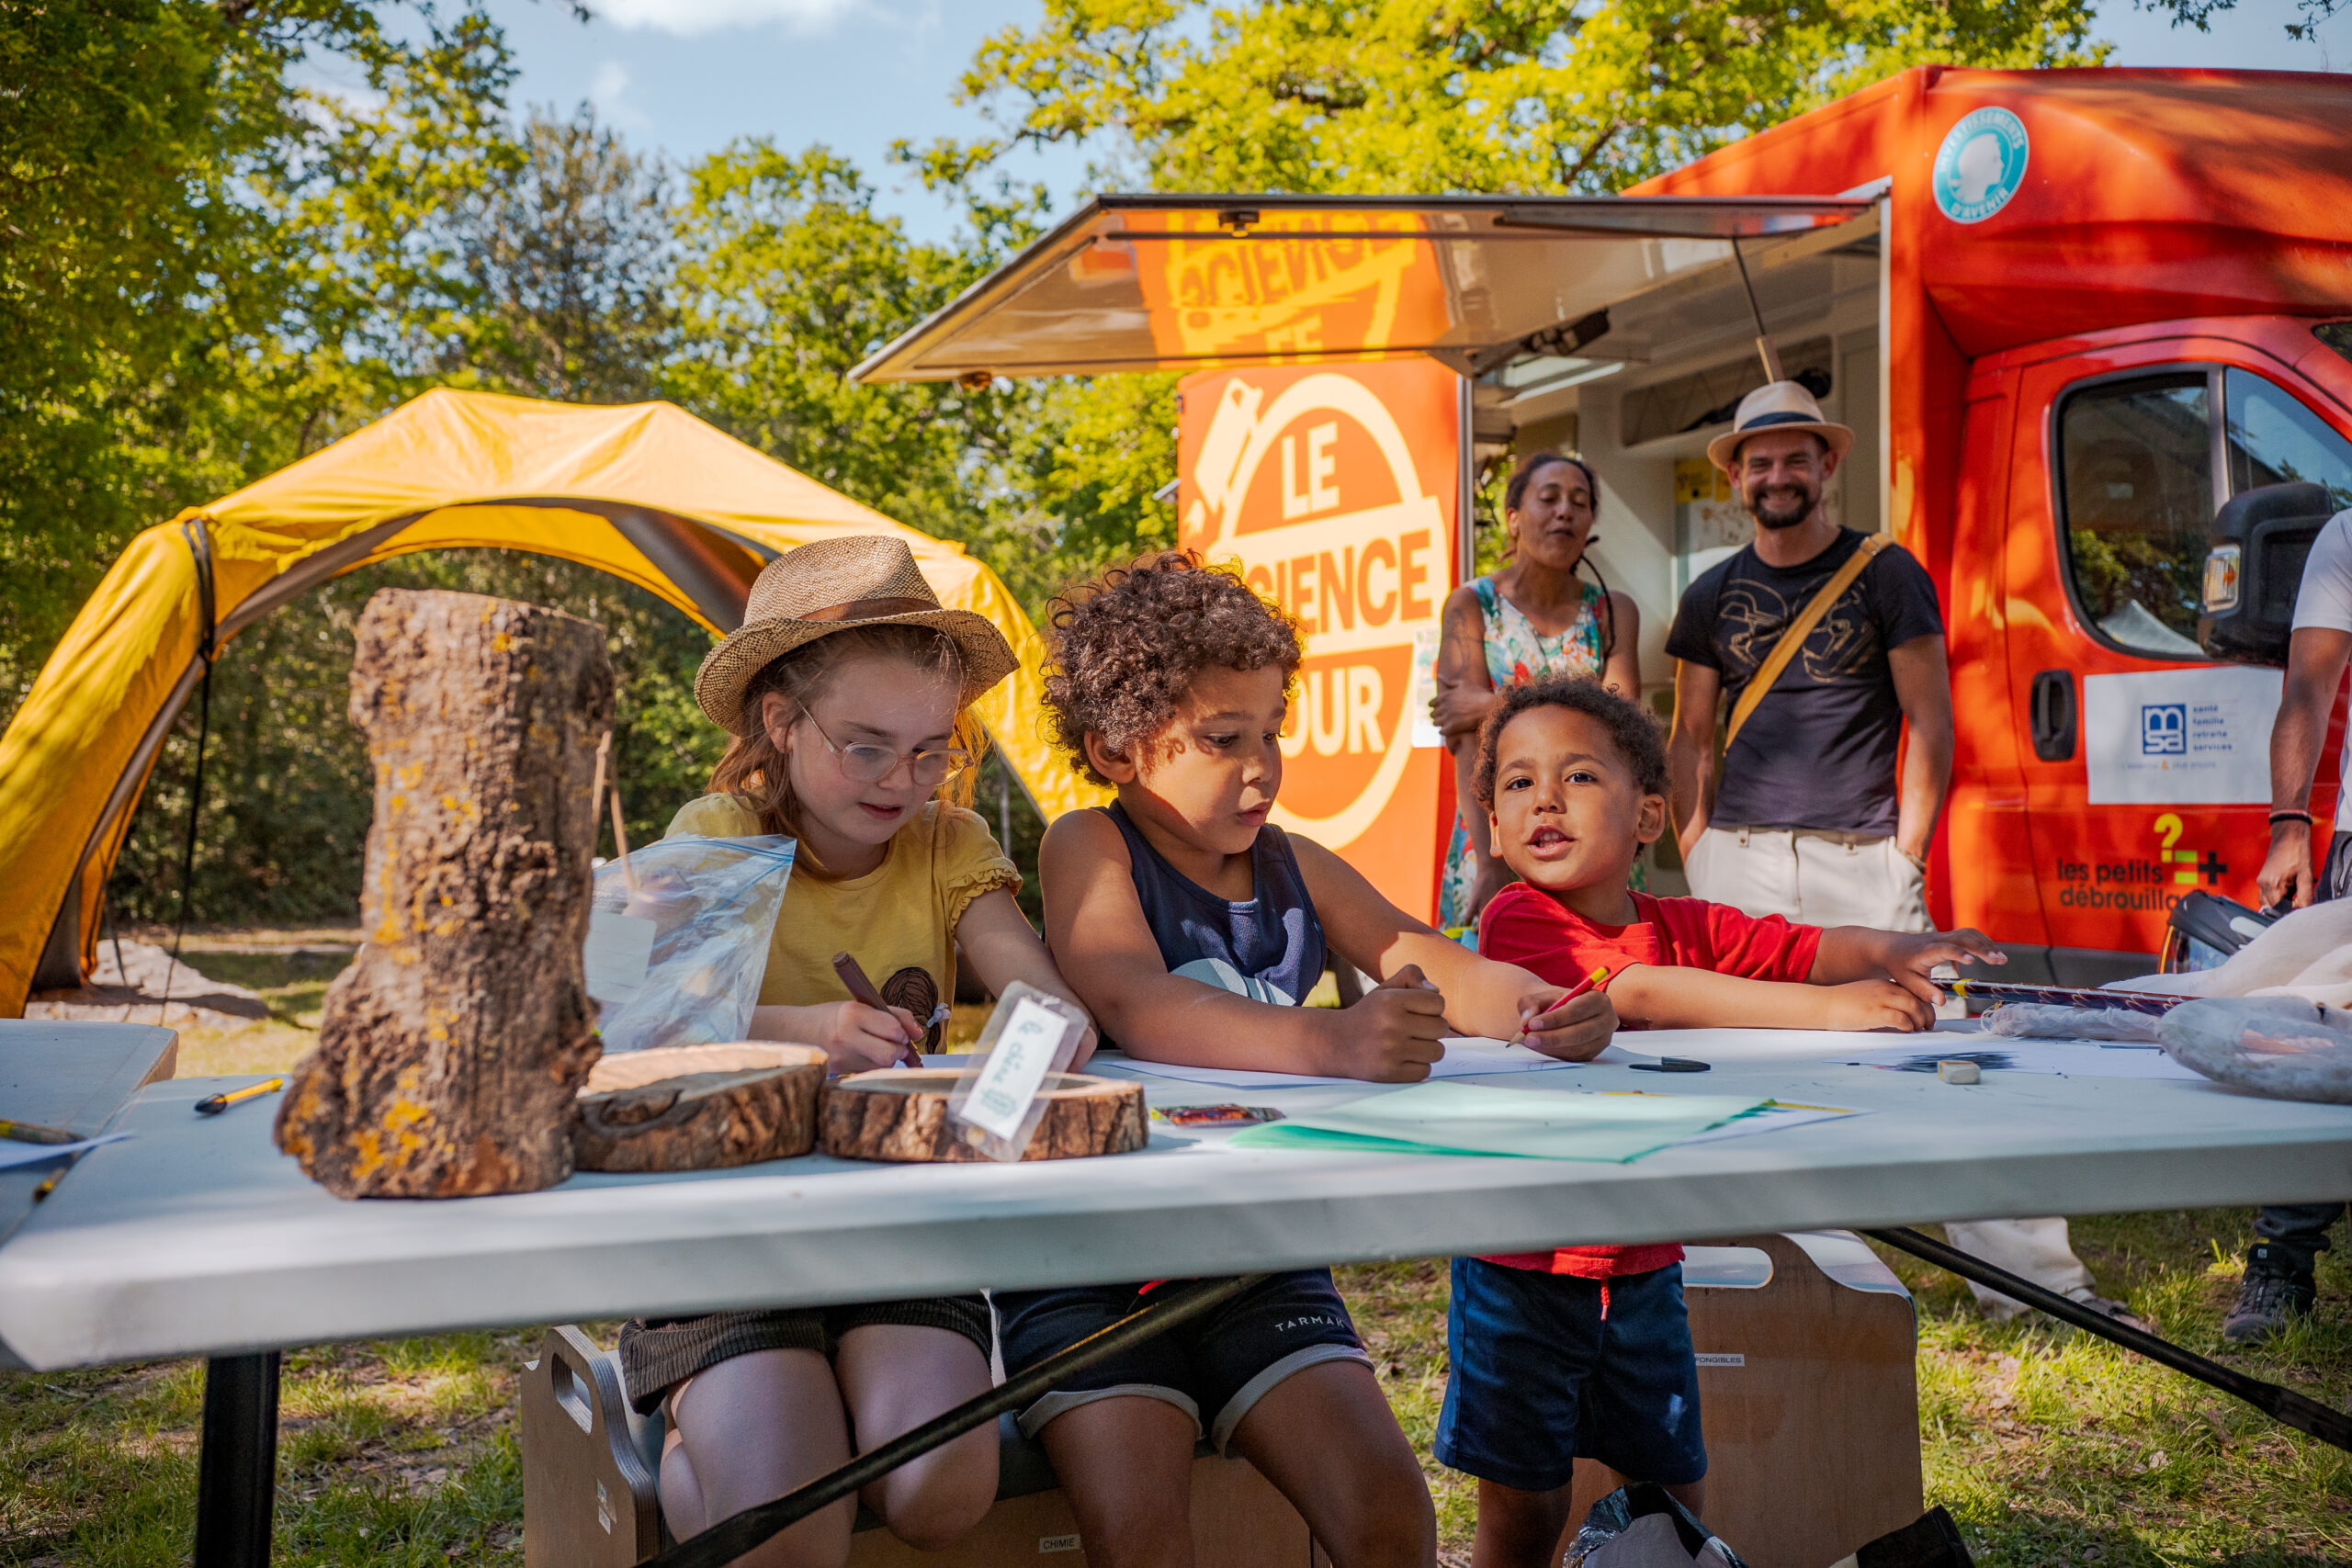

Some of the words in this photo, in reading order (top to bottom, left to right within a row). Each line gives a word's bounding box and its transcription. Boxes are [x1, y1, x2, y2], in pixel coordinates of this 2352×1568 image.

[1938, 110, 2025, 173] INVESTISSEMENTS
[1950, 186, 2010, 219] D'AVENIR
[1281, 420, 1340, 521] LE
[2192, 716, 2225, 727] famille
[2058, 857, 2089, 881] les
[2097, 859, 2164, 886] petits
[2060, 883, 2180, 911] débrouilla
[1275, 1315, 1345, 1332] TARMAK
[1043, 1538, 1075, 1550] CHIMIE
